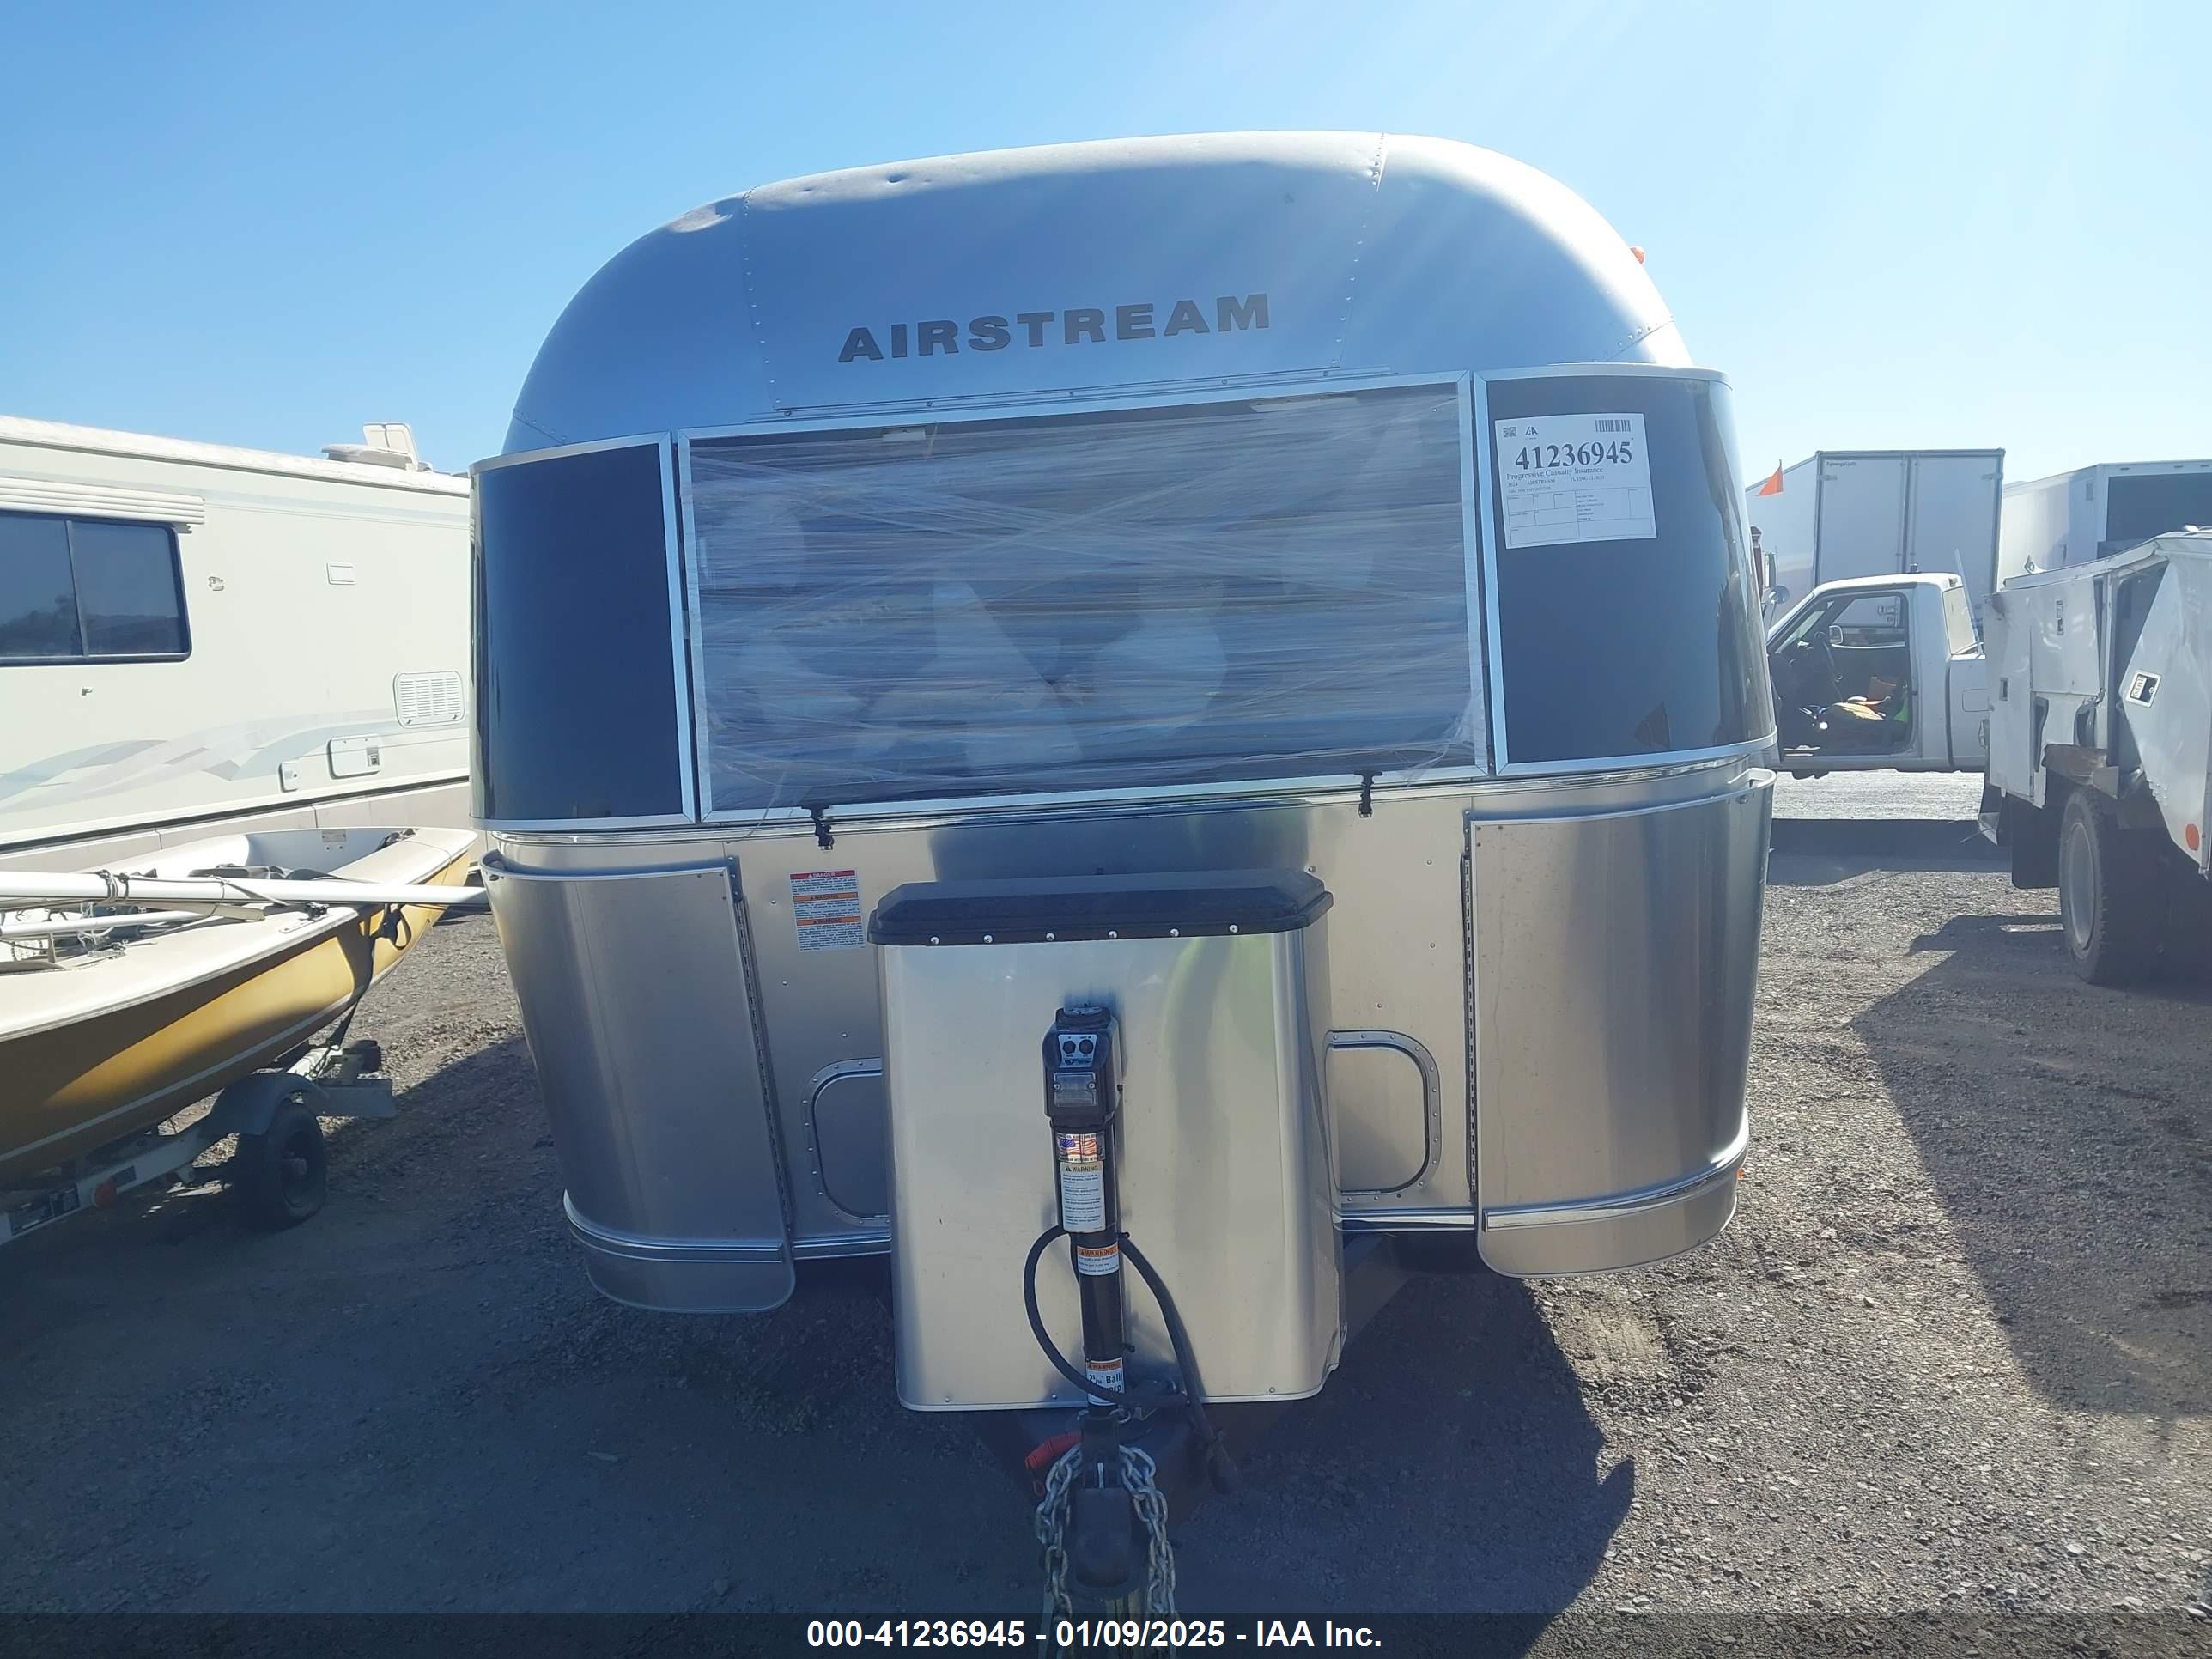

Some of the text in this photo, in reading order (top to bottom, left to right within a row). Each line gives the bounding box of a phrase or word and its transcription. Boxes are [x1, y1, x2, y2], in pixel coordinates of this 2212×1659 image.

[838, 293, 1269, 362] AIRSTREAM
[1515, 441, 1633, 471] 41236945
[1507, 471, 1545, 482] Progressive
[1546, 468, 1572, 477] Casualty
[1085, 1249, 1115, 1257] WARNING
[1092, 1362, 1121, 1370] WARNING
[1106, 1373, 1121, 1383] Ball
